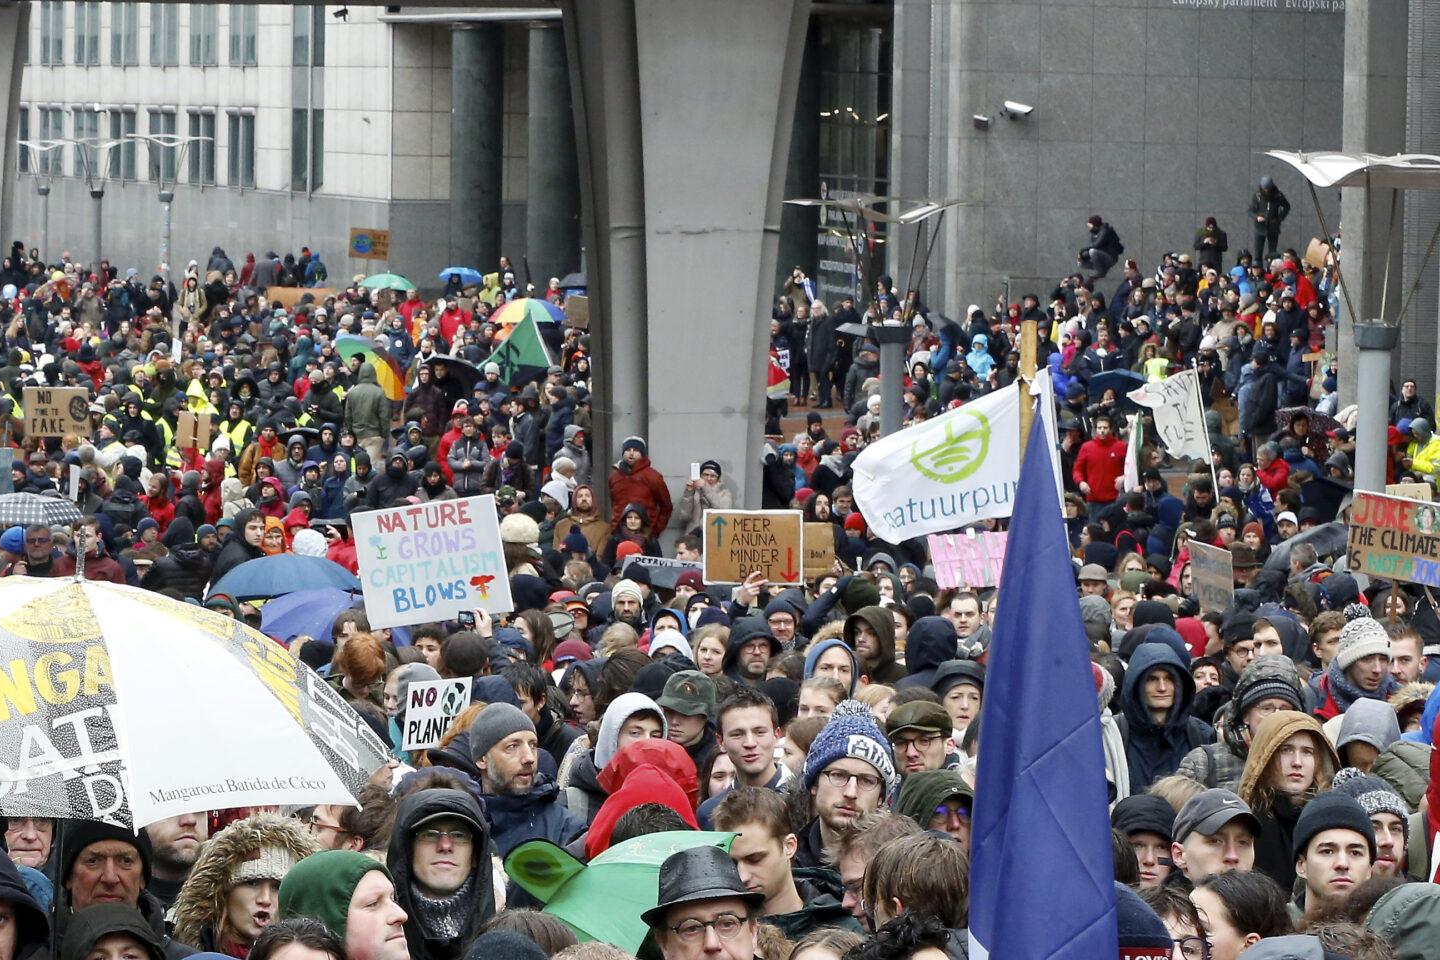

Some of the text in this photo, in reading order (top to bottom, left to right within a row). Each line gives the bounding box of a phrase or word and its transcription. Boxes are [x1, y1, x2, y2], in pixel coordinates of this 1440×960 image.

[37, 391, 52, 405] NO
[32, 418, 65, 433] FAKE
[376, 501, 472, 533] NATURE
[883, 480, 1019, 531] natuurpu
[1354, 493, 1413, 531] JOKE
[731, 533, 777, 547] ANUNA
[733, 518, 770, 532] MEER
[398, 528, 477, 560] GROWS
[730, 549, 779, 563] MINDER
[1350, 525, 1440, 557] THE CLIMATE
[369, 552, 500, 588] CAPITALISM
[1366, 552, 1401, 575] NOT
[1400, 557, 1413, 577] A
[1410, 557, 1440, 588] JOK
[392, 580, 467, 613] BLOWS
[412, 687, 437, 709] NO
[408, 717, 455, 745] PLANE
[149, 782, 225, 805] Mangaroca
[225, 777, 270, 793] Batida
[271, 777, 287, 790] de
